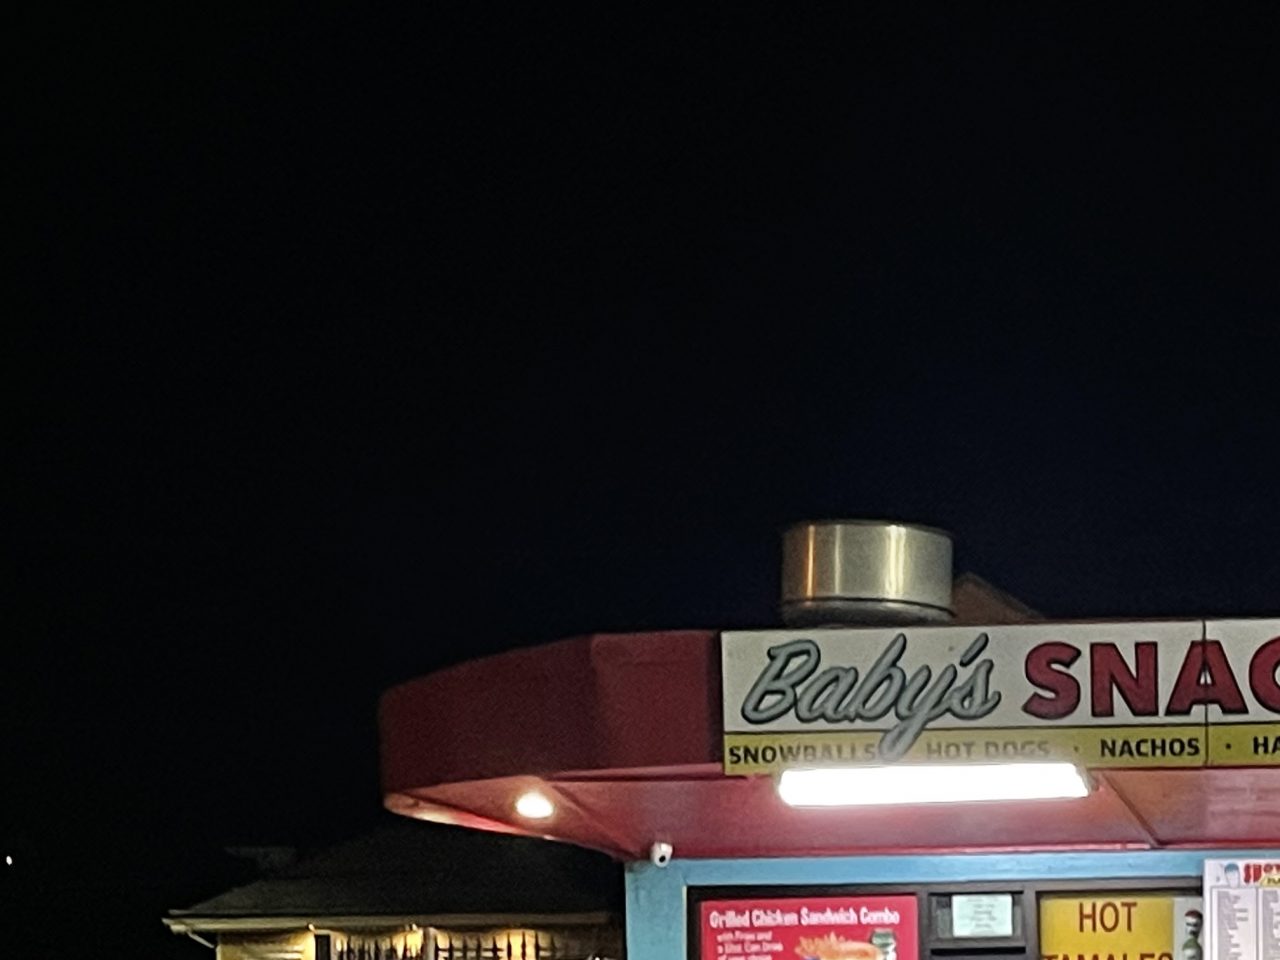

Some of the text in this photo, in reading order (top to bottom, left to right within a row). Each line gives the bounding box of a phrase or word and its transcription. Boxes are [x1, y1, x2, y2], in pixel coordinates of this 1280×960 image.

[741, 632, 1001, 761] Baby's
[728, 743, 876, 765] SNOWBALLS
[925, 742, 978, 761] HOT
[1100, 738, 1200, 758] NACHOS
[708, 906, 900, 928] Grilled Chicken Sandwich Combo
[1079, 902, 1138, 933] HOT
